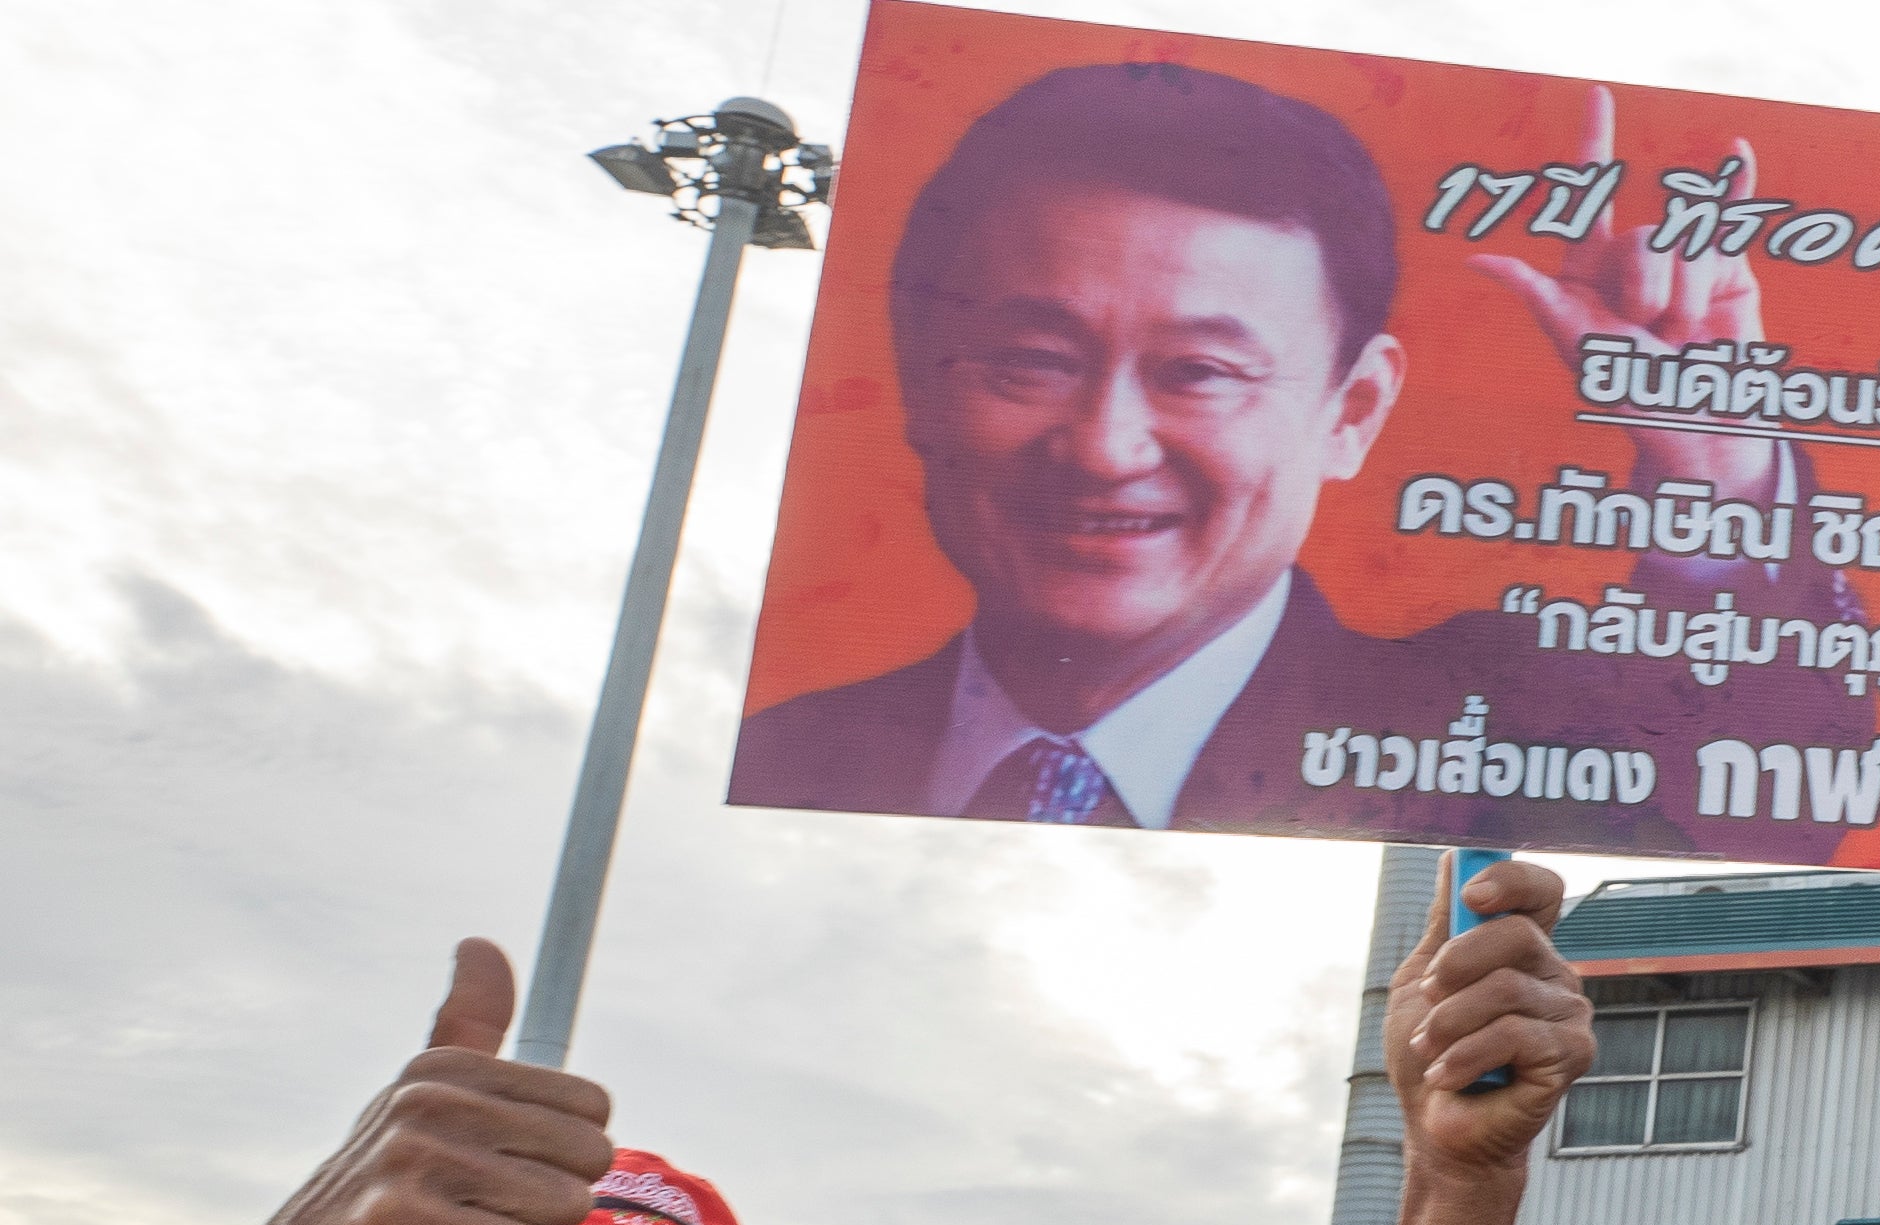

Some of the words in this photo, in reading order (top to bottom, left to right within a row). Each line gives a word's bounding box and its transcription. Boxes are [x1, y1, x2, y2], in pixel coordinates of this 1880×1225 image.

[1423, 160, 1622, 240] 17ปี
[1399, 470, 1791, 563] ดร.ทักษิณ
[1303, 696, 1655, 804] ชาวเสื้อแดง
